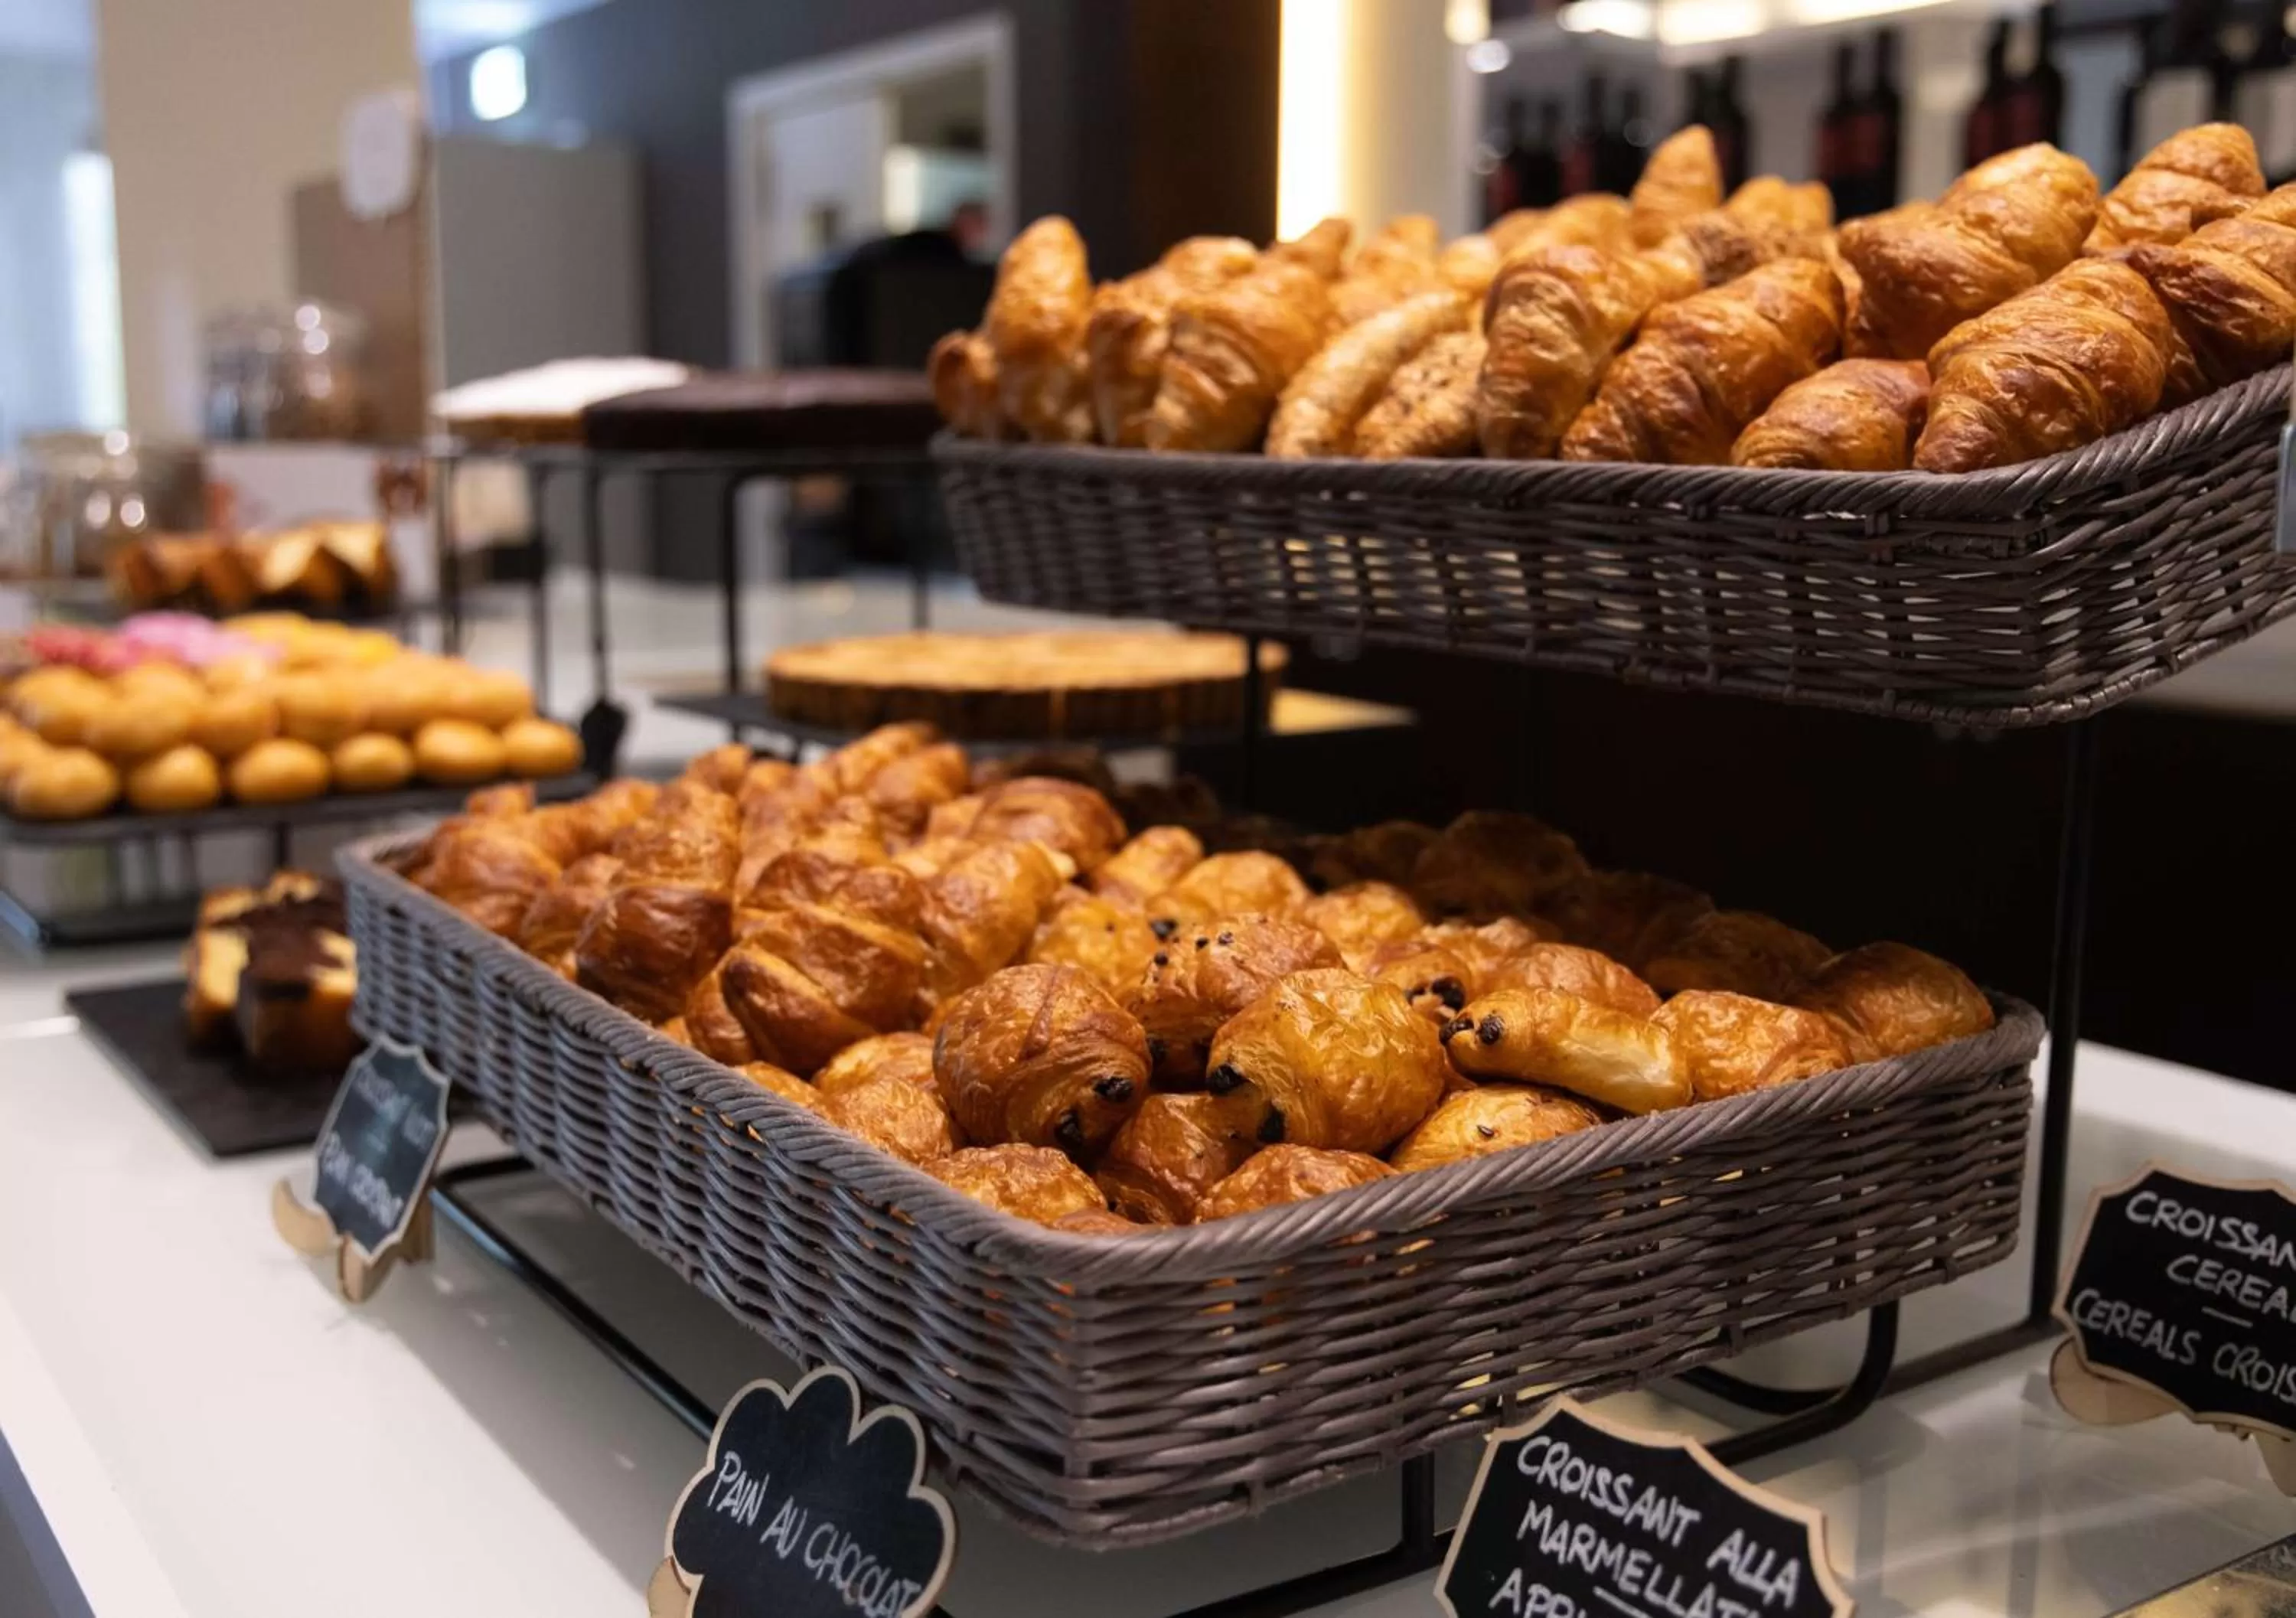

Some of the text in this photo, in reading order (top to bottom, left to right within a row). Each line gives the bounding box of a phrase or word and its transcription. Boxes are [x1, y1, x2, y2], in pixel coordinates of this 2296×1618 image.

[2072, 1287, 2202, 1365] CEREALS
[2166, 1255, 2296, 1324] CEREA
[707, 1451, 921, 1618] PAIN AU CHOCOLAT
[1516, 1499, 1760, 1618] MARMELLAT
[1517, 1436, 1800, 1609] CROISSANT ALLA
